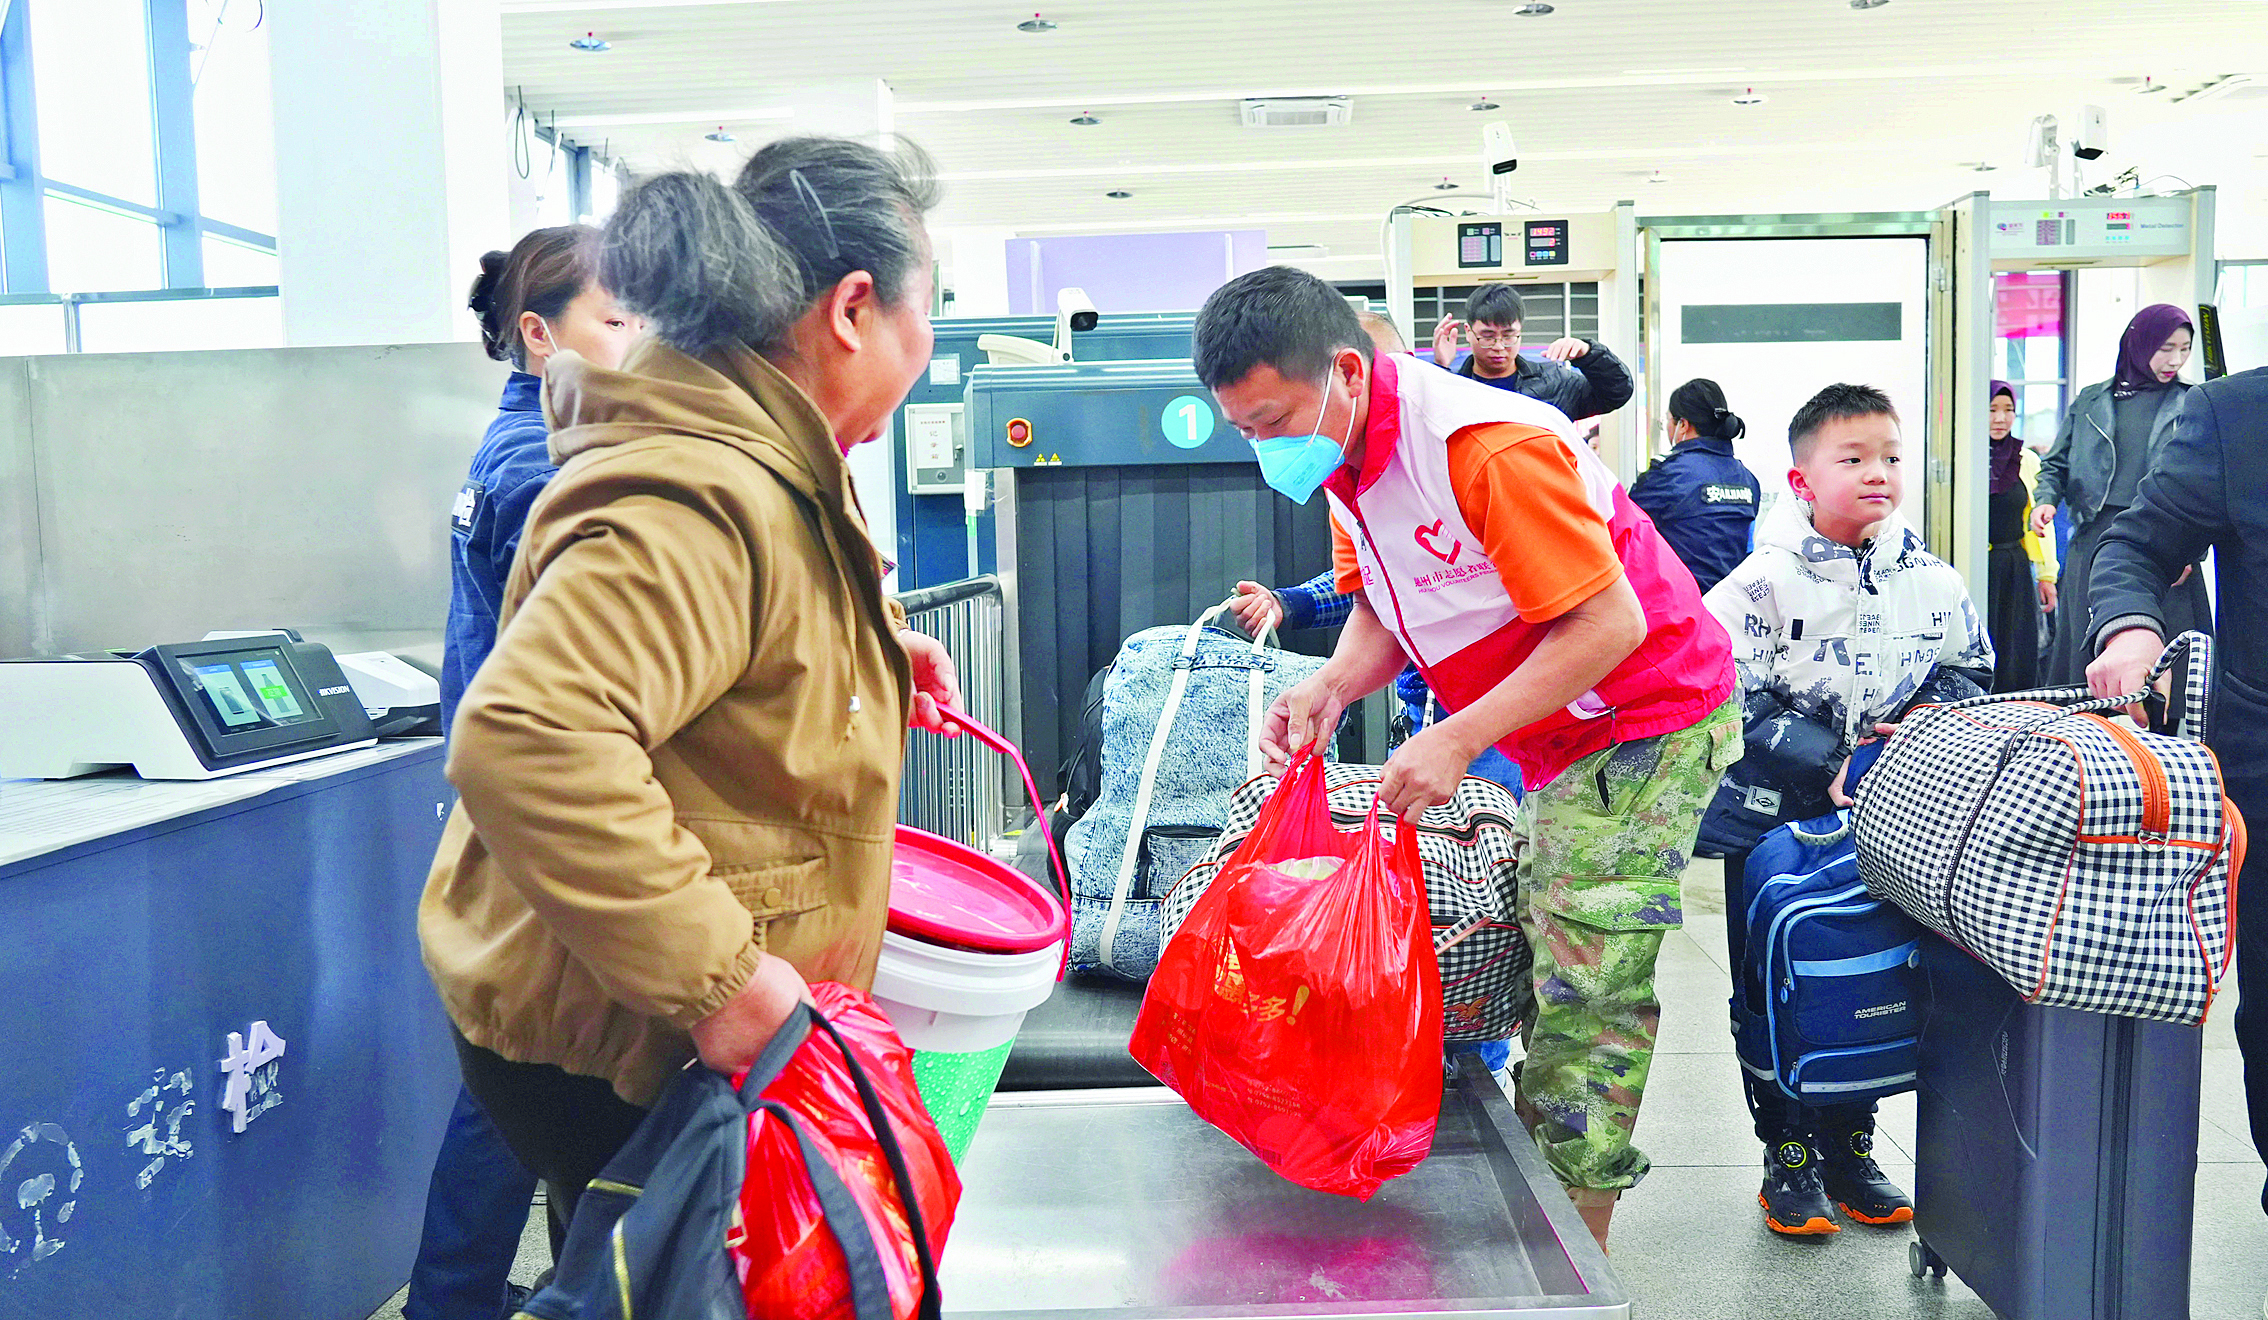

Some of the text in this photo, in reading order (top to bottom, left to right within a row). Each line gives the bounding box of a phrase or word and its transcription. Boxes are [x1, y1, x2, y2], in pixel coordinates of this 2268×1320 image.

[1532, 227, 1555, 236] 1492
[1178, 404, 1198, 440] 1
[1854, 1000, 1907, 1015] AMERICAN
[1854, 1005, 1907, 1020] TOURISTER
